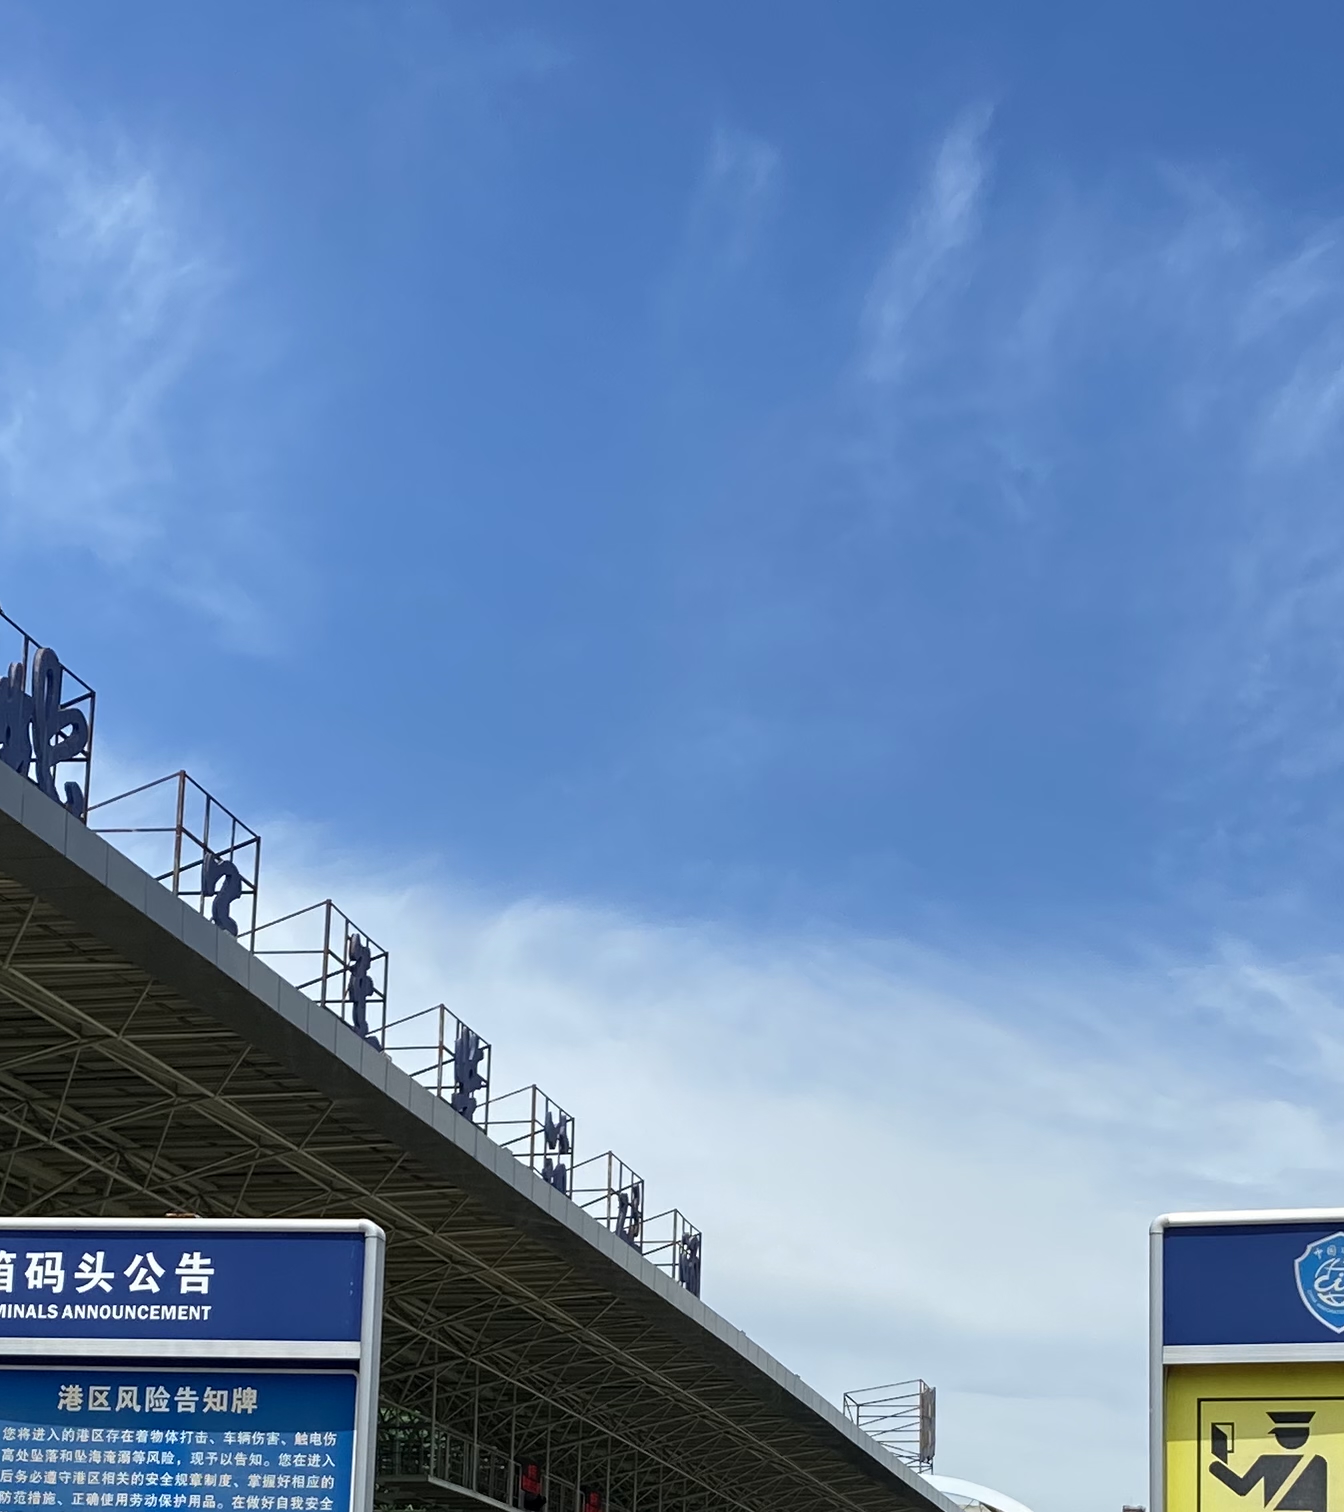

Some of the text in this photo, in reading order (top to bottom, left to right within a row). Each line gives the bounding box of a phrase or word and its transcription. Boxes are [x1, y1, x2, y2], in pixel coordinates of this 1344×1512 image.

[62, 1305, 211, 1320] ANNOUNCEMENT
[58, 1384, 258, 1414] 港区风险告知牌
